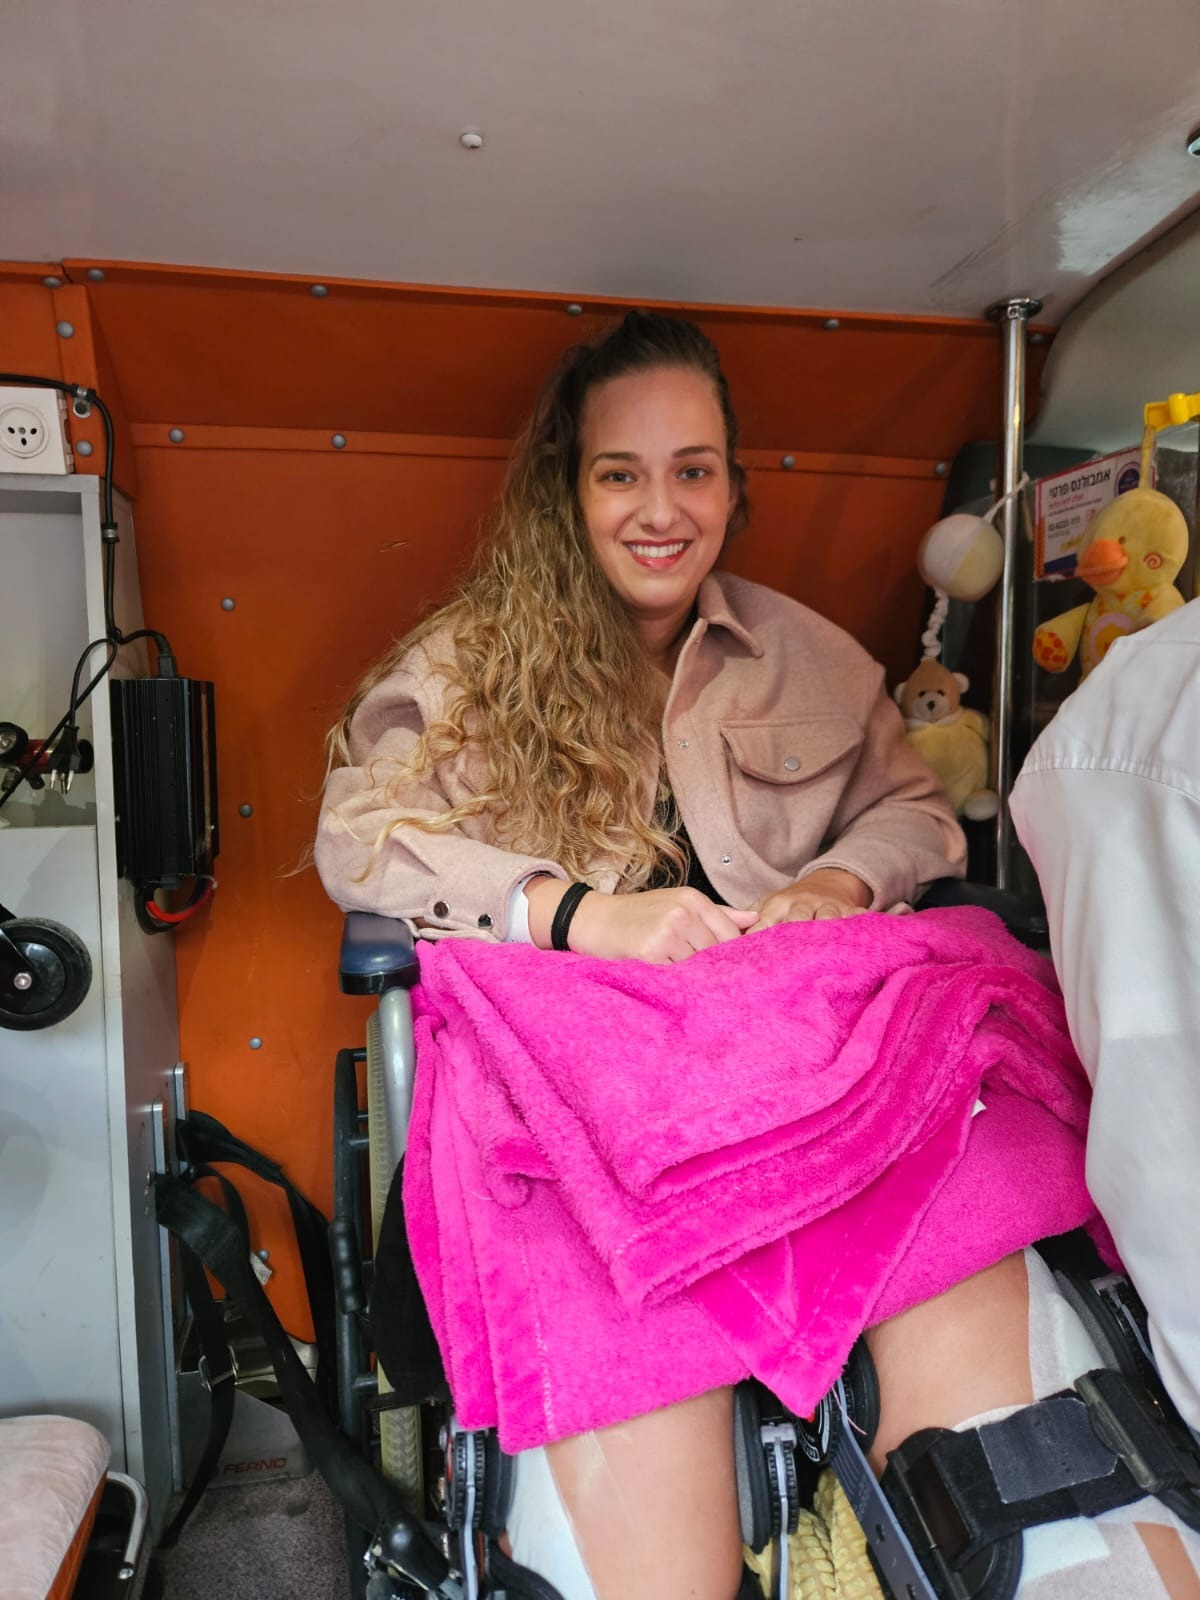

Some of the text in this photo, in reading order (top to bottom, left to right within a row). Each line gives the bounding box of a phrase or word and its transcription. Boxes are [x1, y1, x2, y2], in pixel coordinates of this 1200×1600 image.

[1071, 468, 1110, 491] אמבולנס
[1049, 482, 1069, 498] פרטי
[223, 1458, 287, 1473] FERNO
